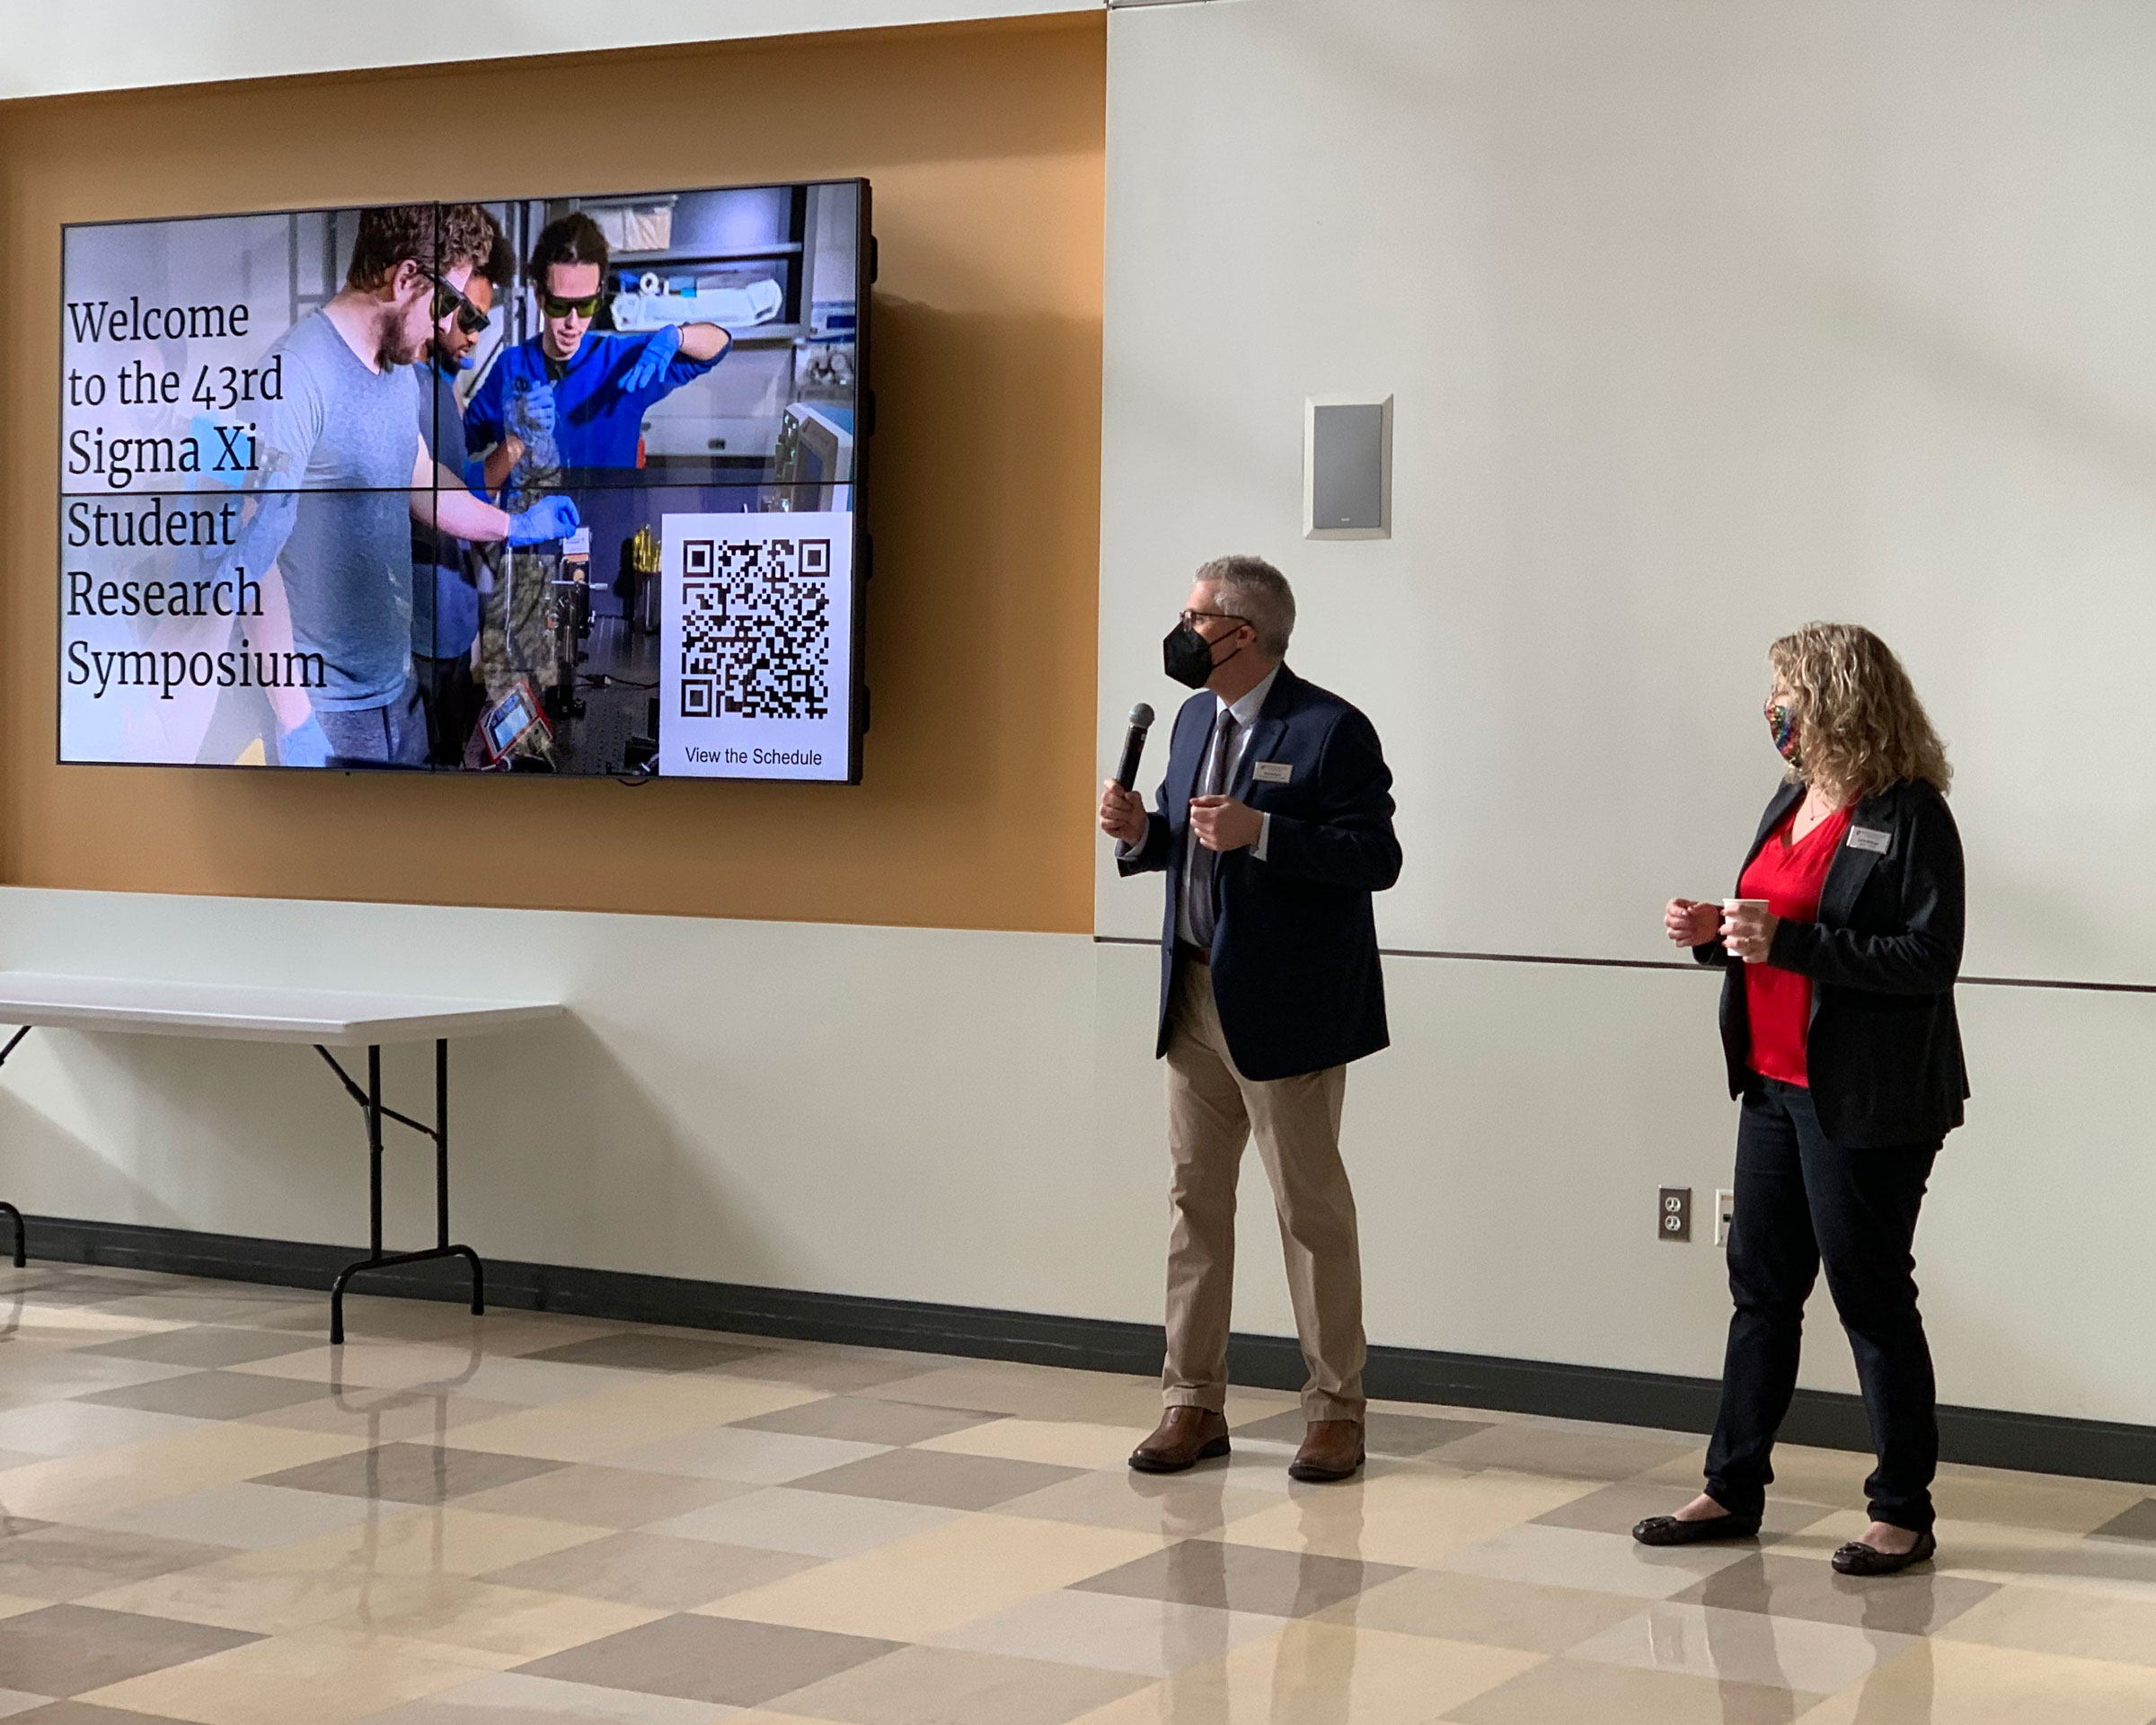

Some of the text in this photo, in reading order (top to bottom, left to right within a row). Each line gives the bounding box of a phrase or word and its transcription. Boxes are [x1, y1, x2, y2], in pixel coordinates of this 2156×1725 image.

[68, 296, 249, 343] Welcome
[69, 355, 283, 410] to the 43rd
[68, 423, 259, 488] Sigma Xi
[67, 498, 236, 546] Student
[67, 567, 264, 616] Research
[67, 639, 327, 699] Symposium
[685, 747, 822, 765] View the Schedule
